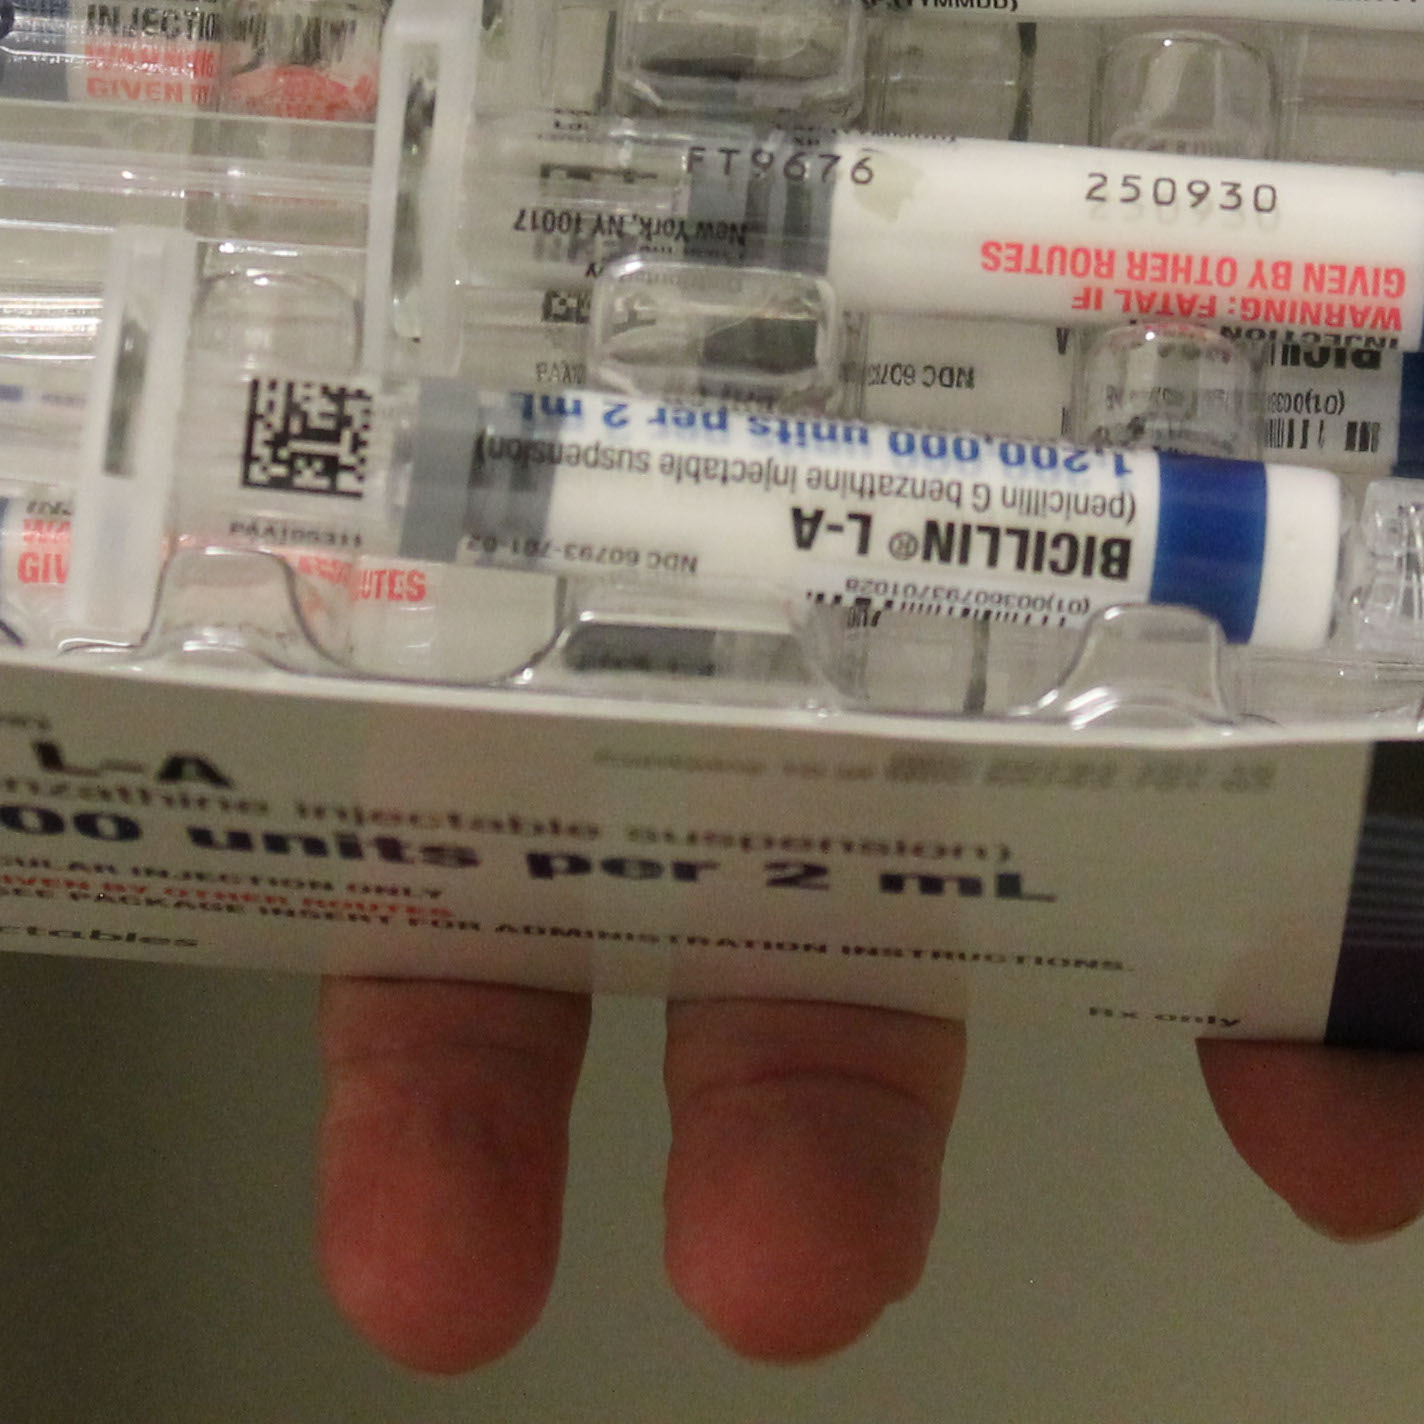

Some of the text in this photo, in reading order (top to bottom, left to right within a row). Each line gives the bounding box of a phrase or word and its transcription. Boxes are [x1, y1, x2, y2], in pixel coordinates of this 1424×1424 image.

[686, 146, 875, 186] FT9676
[1085, 172, 1278, 214] 250930
[513, 208, 582, 235] 10017
[592, 212, 625, 240] NY
[980, 239, 1406, 299] GIVEN BY OTHER ROUTES
[1072, 285, 1404, 332] WARNING: FATAL IF
[922, 364, 975, 389] NDC
[603, 402, 628, 429] 2
[648, 405, 729, 432] per
[747, 414, 869, 448] units
[474, 428, 1136, 524] (penicillin G benzathine injectable suspension)
[646, 551, 699, 574] NDC
[791, 506, 1132, 581] BICILLIN® L-A
[31, 738, 234, 789] L-A
[186, 824, 480, 868] units
[526, 850, 720, 884] per
[764, 861, 830, 891] 2
[878, 871, 1058, 904] mL
